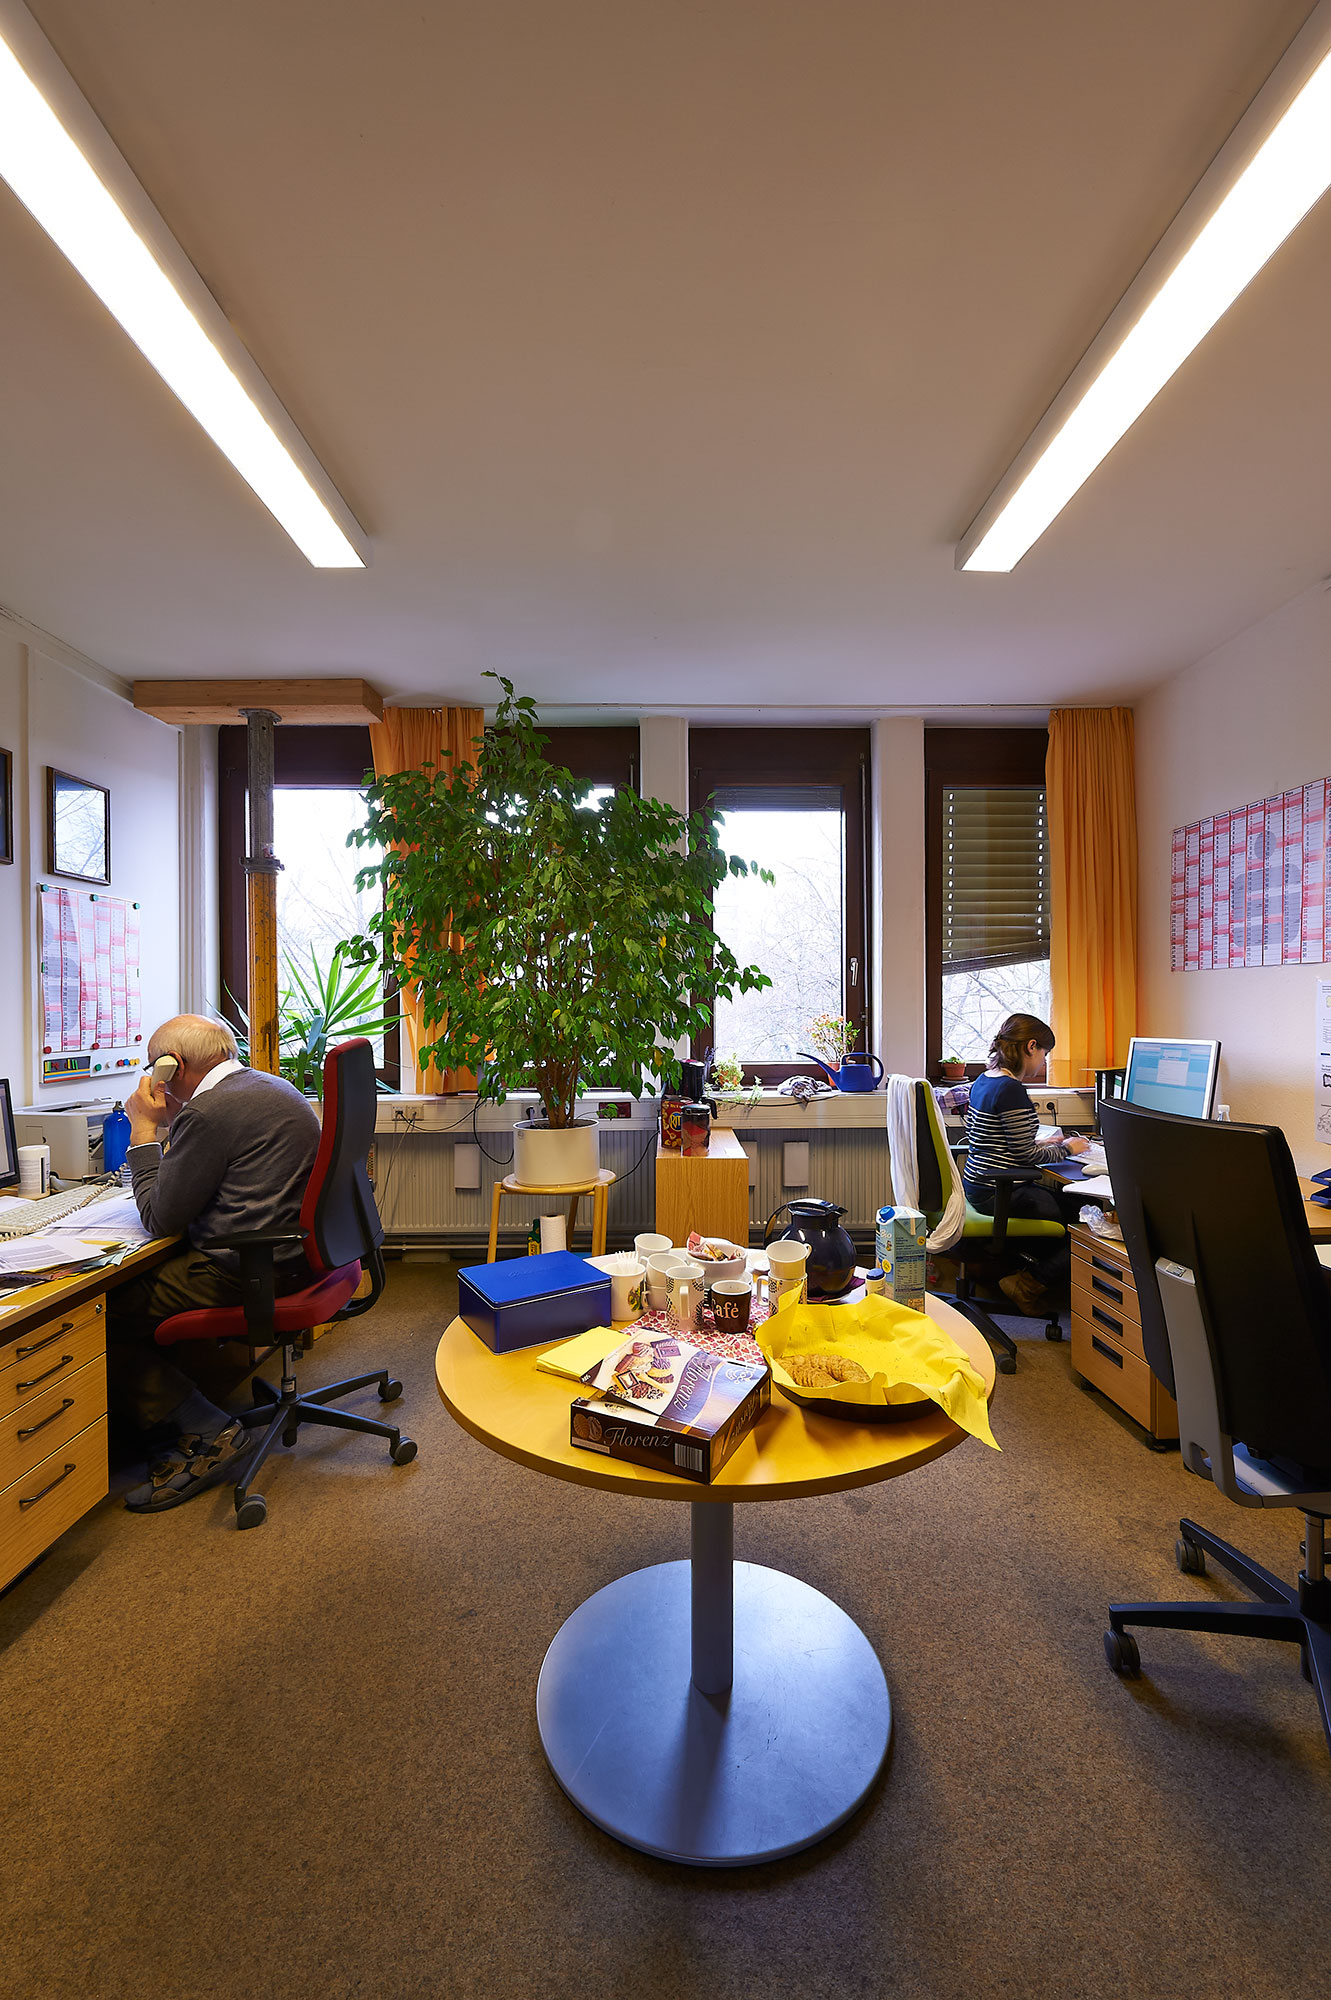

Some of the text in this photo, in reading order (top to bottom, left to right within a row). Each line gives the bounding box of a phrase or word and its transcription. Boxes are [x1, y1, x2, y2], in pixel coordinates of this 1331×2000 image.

[669, 1114, 682, 1129] RIT
[673, 1356, 713, 1411] Florenz
[603, 1426, 672, 1448] Florenz
